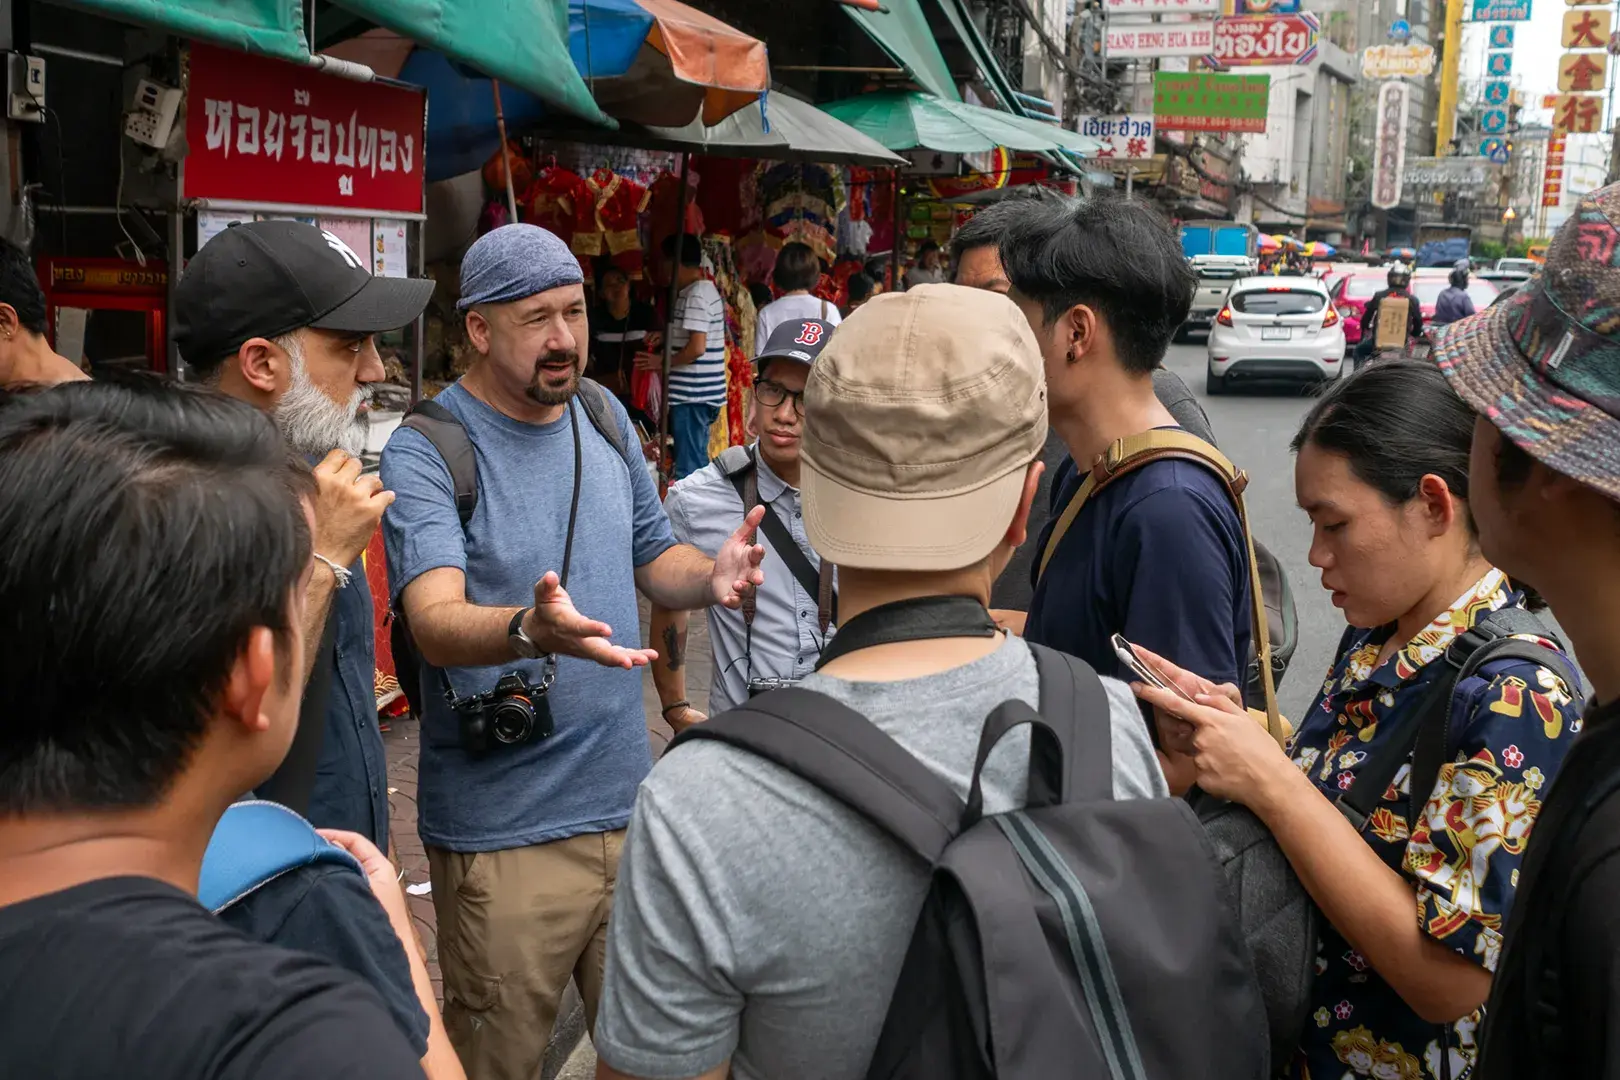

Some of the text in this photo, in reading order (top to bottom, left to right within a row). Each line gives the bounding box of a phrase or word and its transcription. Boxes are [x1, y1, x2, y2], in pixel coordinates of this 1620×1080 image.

[1168, 31, 1187, 47] HUA
[1191, 30, 1211, 46] KEE
[1215, 20, 1307, 57] ทองใบ
[1557, 0, 1606, 133] 大金行
[204, 88, 414, 196] หอยจ๊อปูทอง
[794, 321, 824, 346] B
